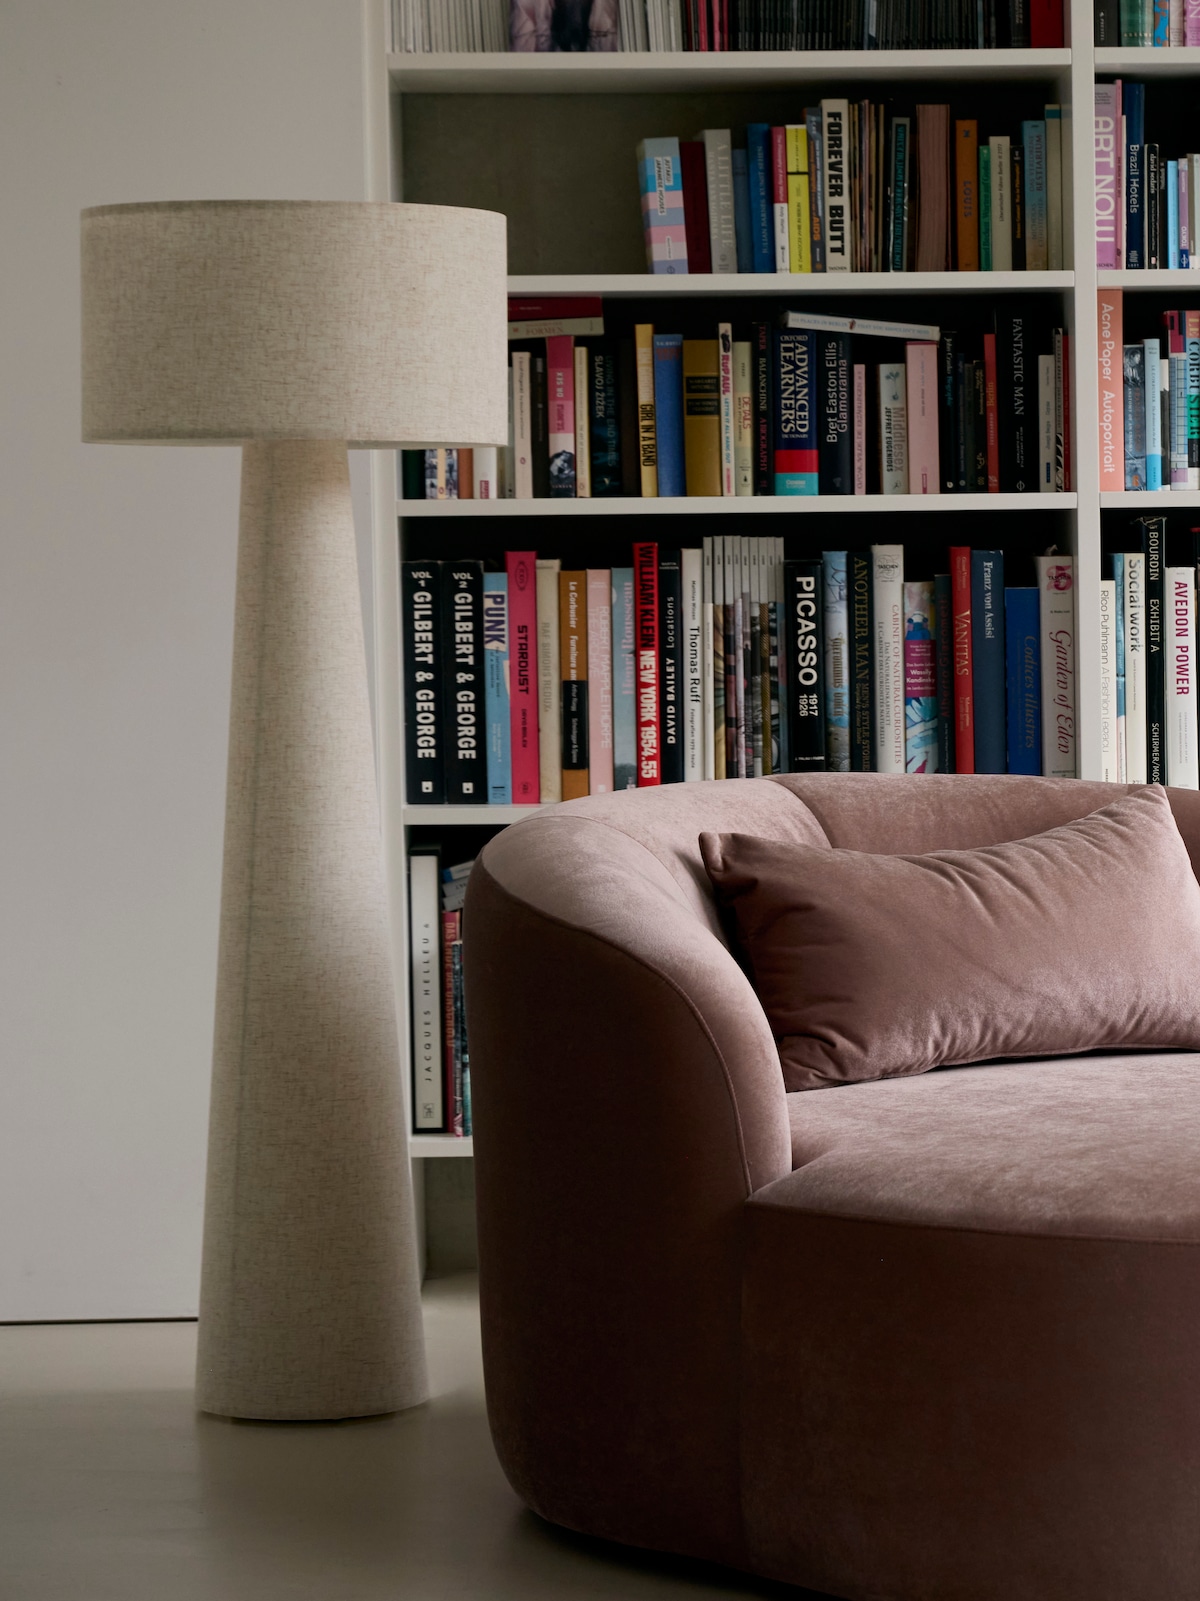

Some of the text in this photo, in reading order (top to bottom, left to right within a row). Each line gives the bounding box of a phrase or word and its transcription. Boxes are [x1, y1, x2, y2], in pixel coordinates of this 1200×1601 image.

[717, 142, 734, 248] A LITTLE LIFE
[827, 111, 845, 255] FOREVER BUTT
[963, 180, 973, 217] LOUIS
[1129, 144, 1140, 213] Brazil Hotels
[594, 356, 606, 418] SLAVOJ ŽIŽEK
[780, 342, 795, 434] LEARNER'S
[795, 342, 809, 433] ADVANCED
[825, 342, 838, 443] Bret Easton Ellis
[838, 359, 848, 433] Glamorama
[1012, 318, 1025, 415] FANTASTIC MAN
[1100, 303, 1115, 473] Acne Paper Autoportrait
[885, 406, 893, 472] JEFFREY EUGENIDES
[894, 406, 906, 472] Middlesex
[485, 594, 505, 644] PUNK
[796, 575, 819, 685] PICASSO
[854, 557, 870, 680] ANOTHER MAN
[955, 609, 971, 676] VANITAS
[983, 561, 995, 639] Franz von Assisi
[1128, 559, 1141, 653] Social work
[1174, 581, 1190, 696] AVEDON POWER
[412, 591, 436, 759] GILBERT & GEORGE
[454, 592, 477, 760] GILBERT & GEORGE
[638, 546, 657, 778] WILLIAM KLEIN NEW YORK 1954.55
[665, 596, 676, 744] DAVID BAILEY Locations
[690, 626, 701, 703] Thomas Ruff
[799, 693, 808, 717] 1926
[809, 693, 819, 717] 1917
